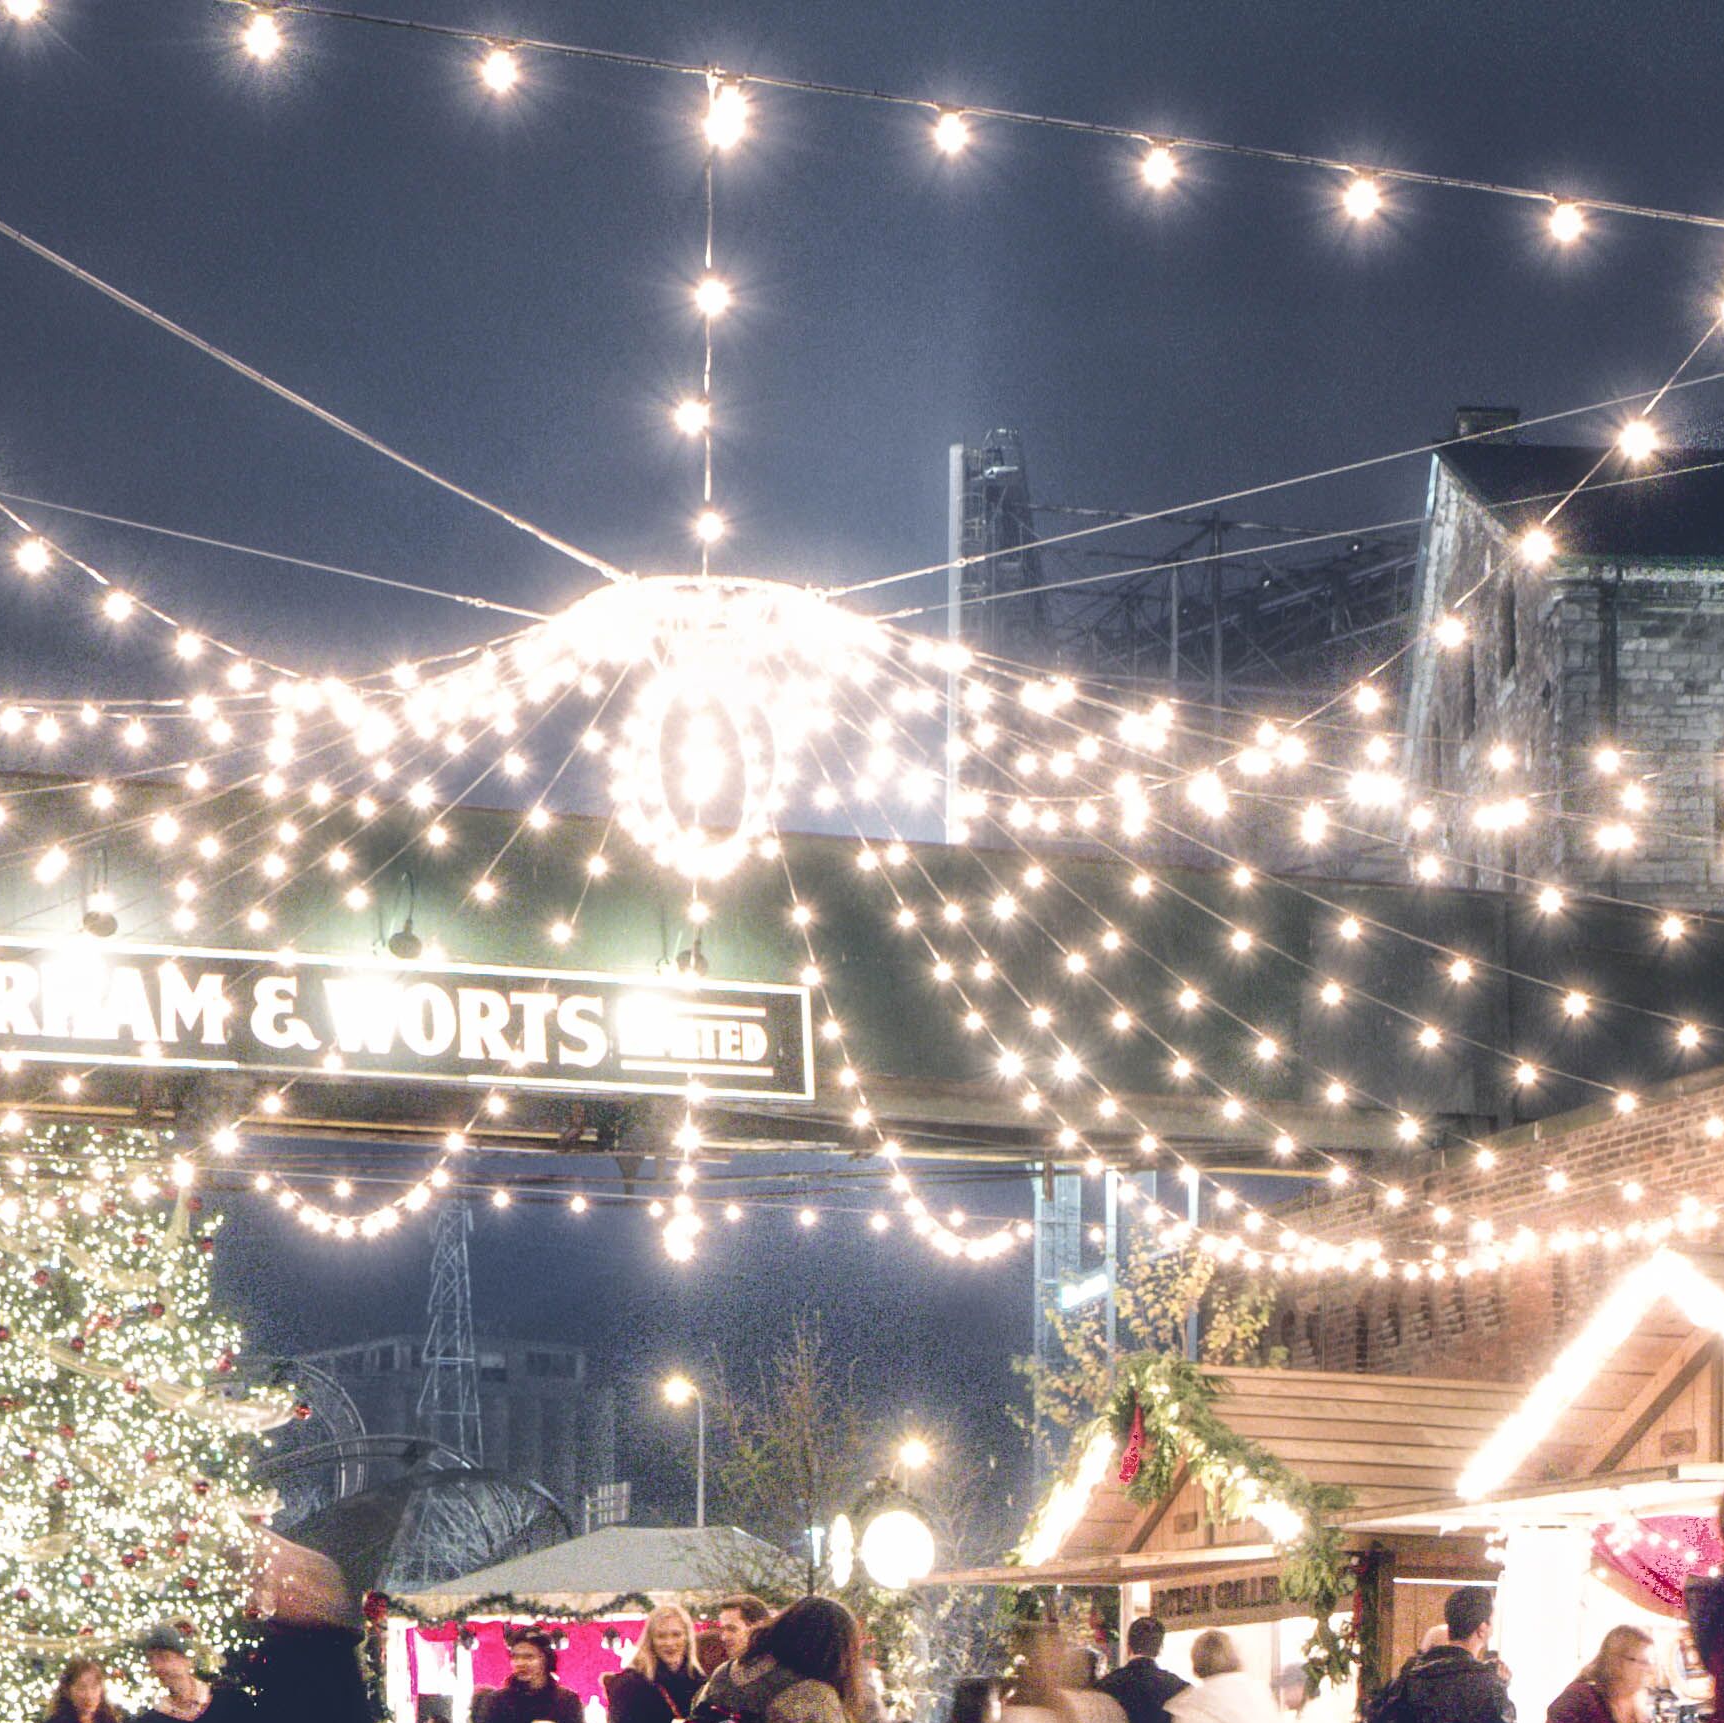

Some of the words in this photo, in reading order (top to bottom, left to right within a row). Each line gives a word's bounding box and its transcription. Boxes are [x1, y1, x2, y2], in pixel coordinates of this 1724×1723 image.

[250, 976, 320, 1051] &
[322, 977, 608, 1067] WORTS
[619, 1014, 767, 1061] ITED
